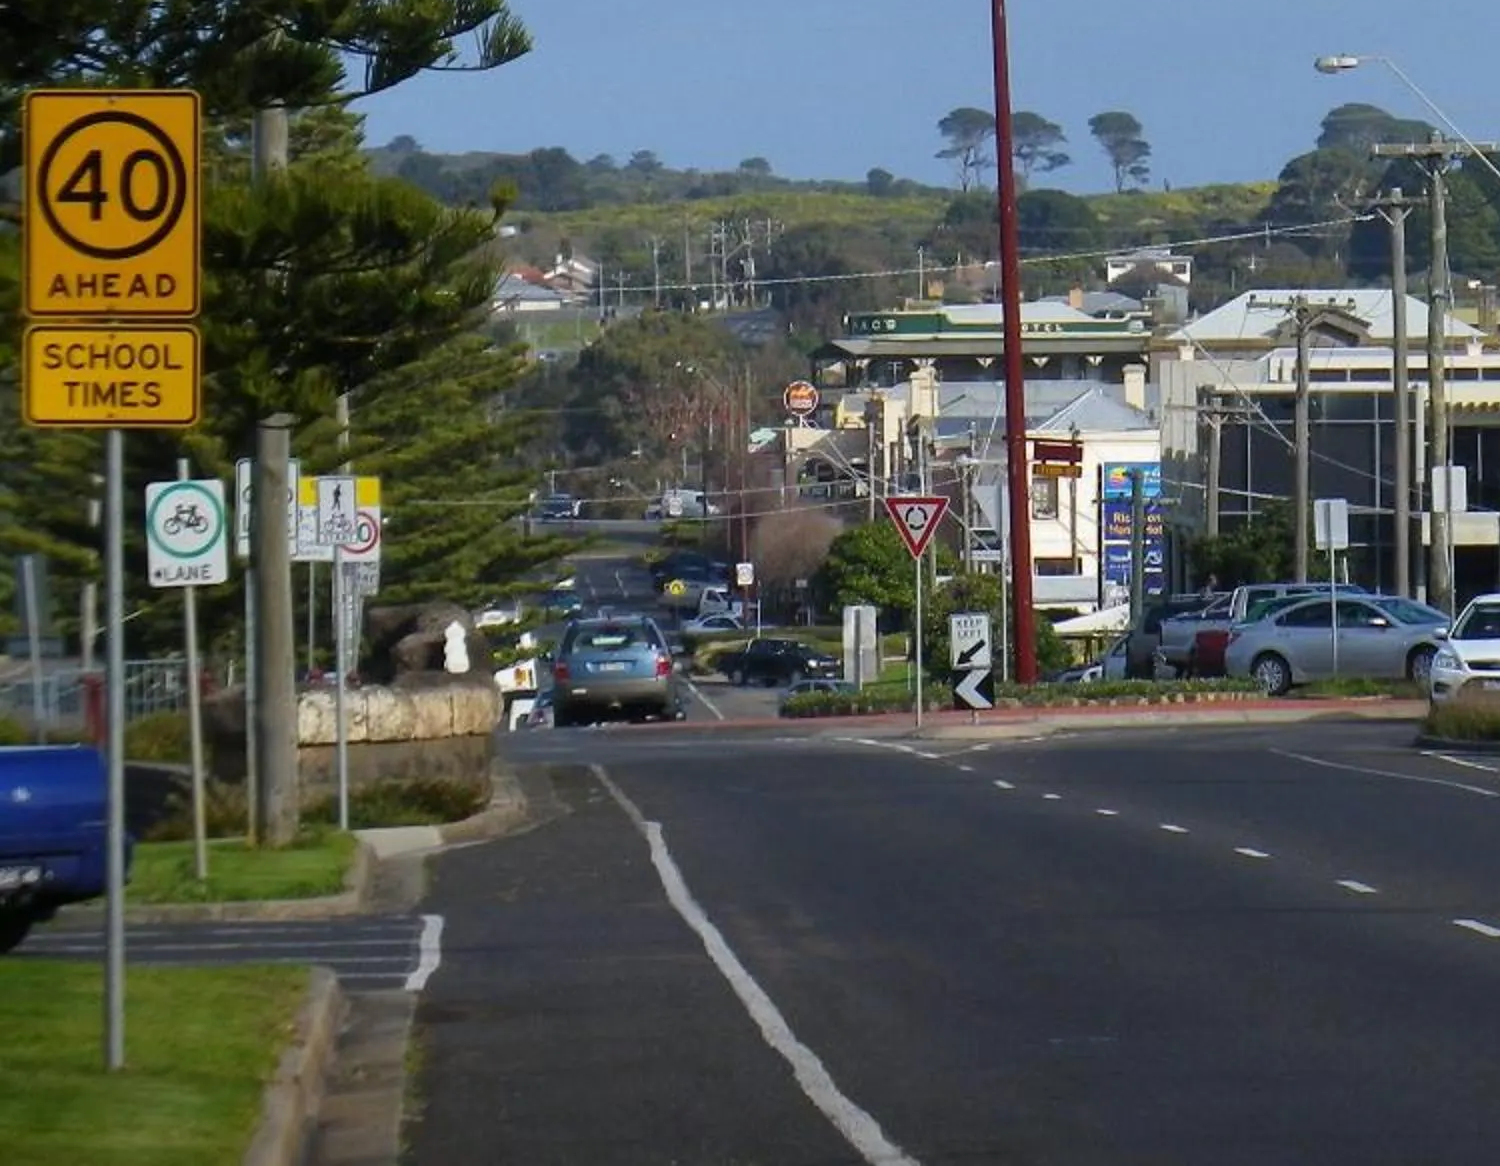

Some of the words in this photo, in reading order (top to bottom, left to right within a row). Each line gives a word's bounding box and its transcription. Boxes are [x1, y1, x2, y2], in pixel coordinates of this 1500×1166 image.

[55, 149, 169, 222] 40
[48, 273, 177, 299] AHEAD
[42, 343, 184, 370] SCHOOL
[63, 381, 162, 408] TIMES
[164, 565, 213, 582] LANE
